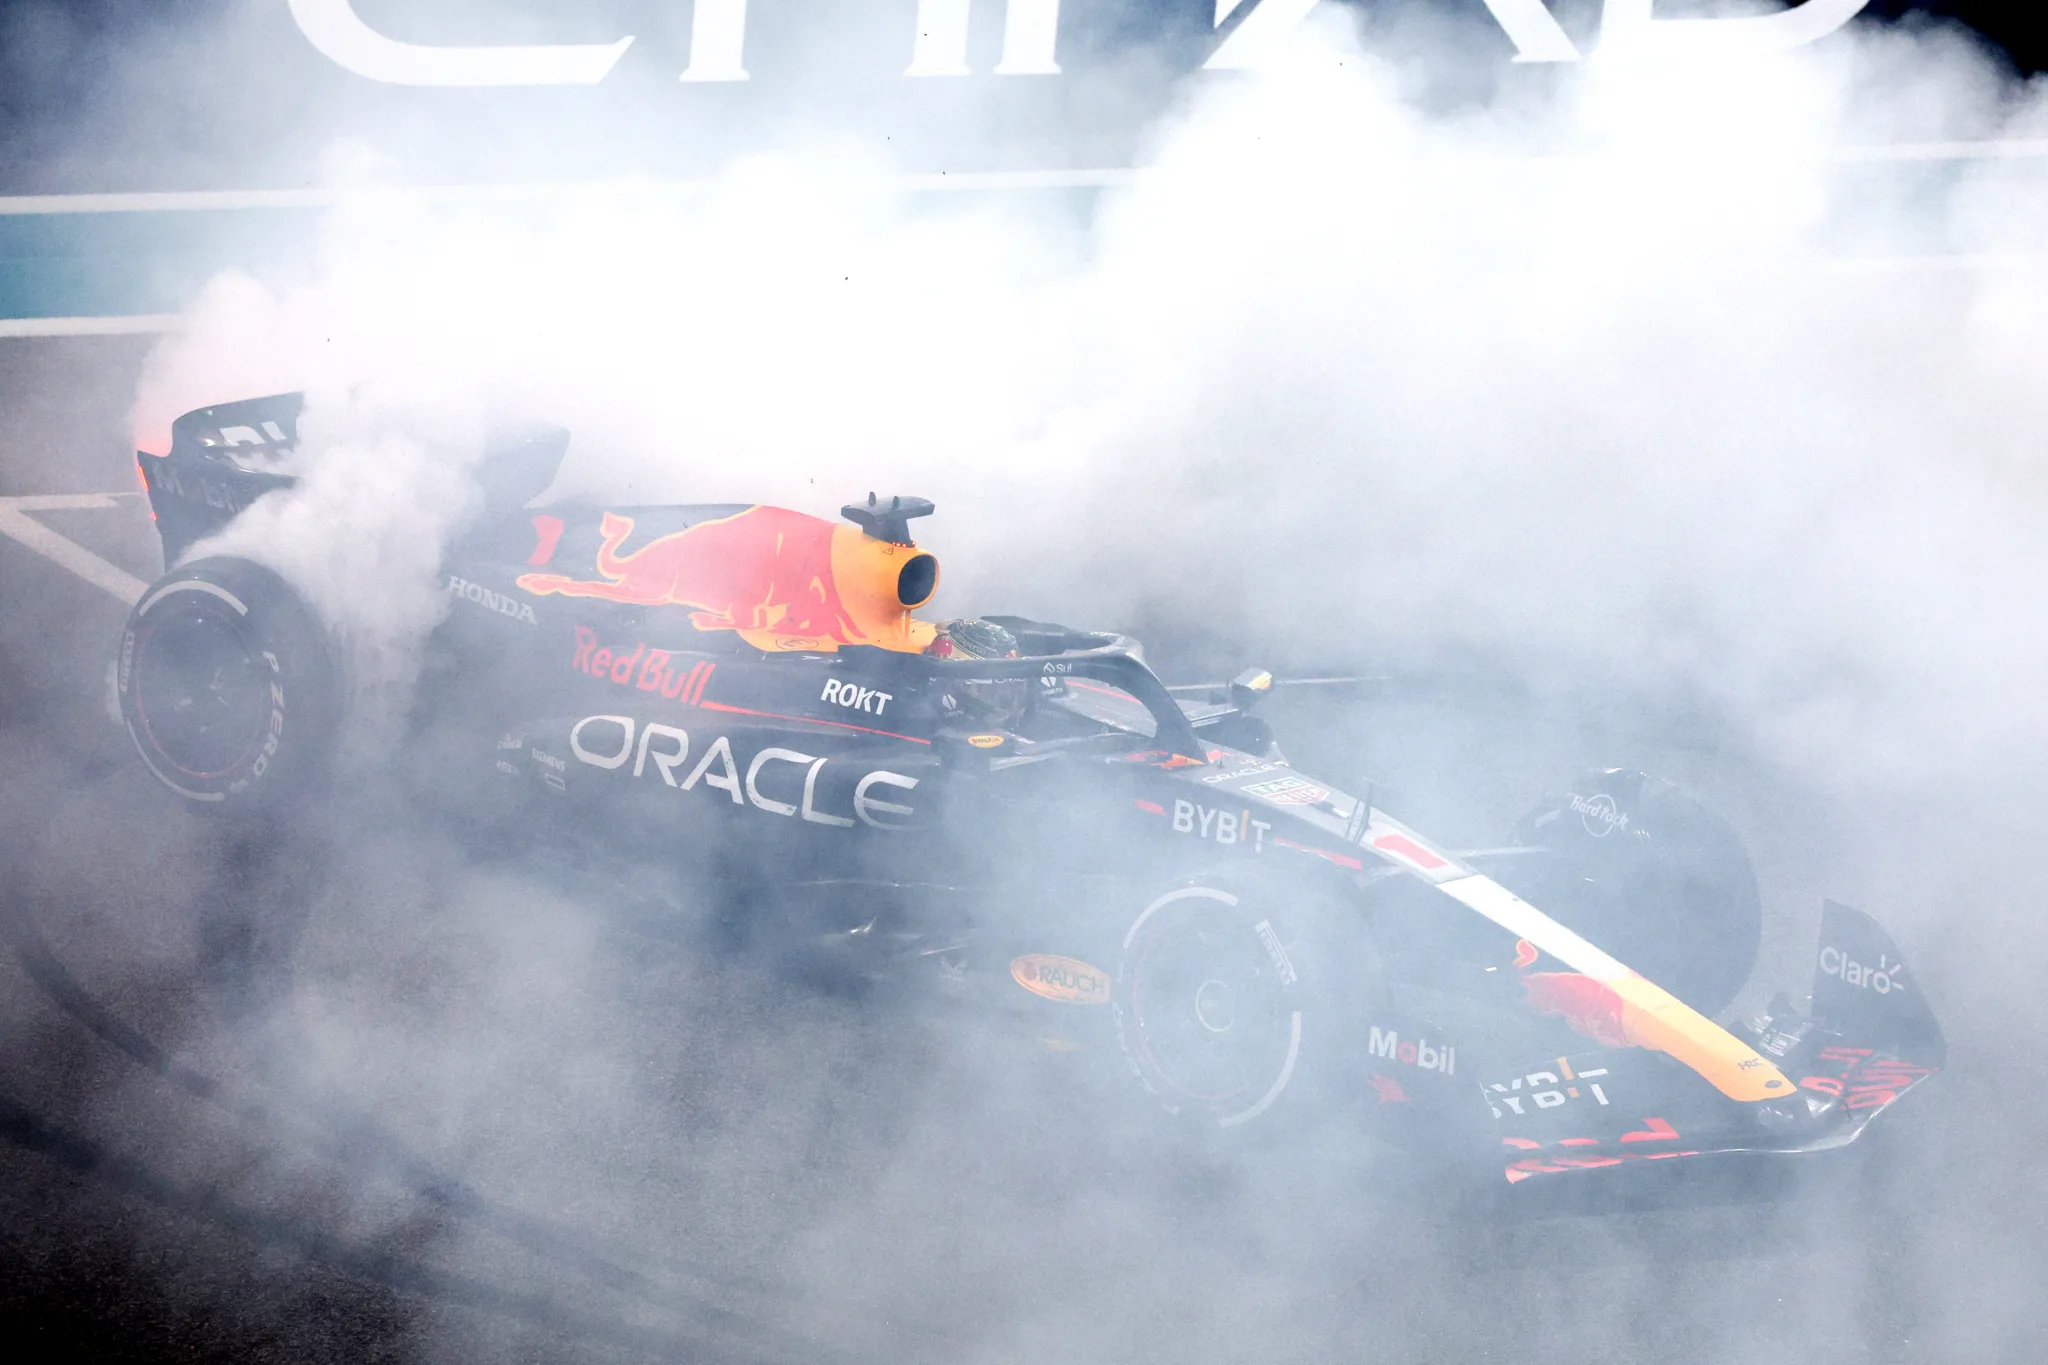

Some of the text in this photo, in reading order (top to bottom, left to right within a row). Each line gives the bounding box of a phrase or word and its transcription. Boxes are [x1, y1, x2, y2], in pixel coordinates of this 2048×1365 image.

[448, 575, 538, 626] HONDA
[572, 624, 718, 705] Red Bull
[820, 678, 893, 716] ROKT
[531, 747, 566, 772] SIEMENS
[568, 714, 921, 831] ORACLE
[1172, 798, 1272, 854] BYBIT
[1566, 792, 1604, 817] Hard
[1039, 965, 1105, 995] RAUCH
[1820, 946, 1891, 995] Claro
[1368, 1025, 1456, 1076] Mobil
[1490, 1056, 1611, 1119] YBIT
